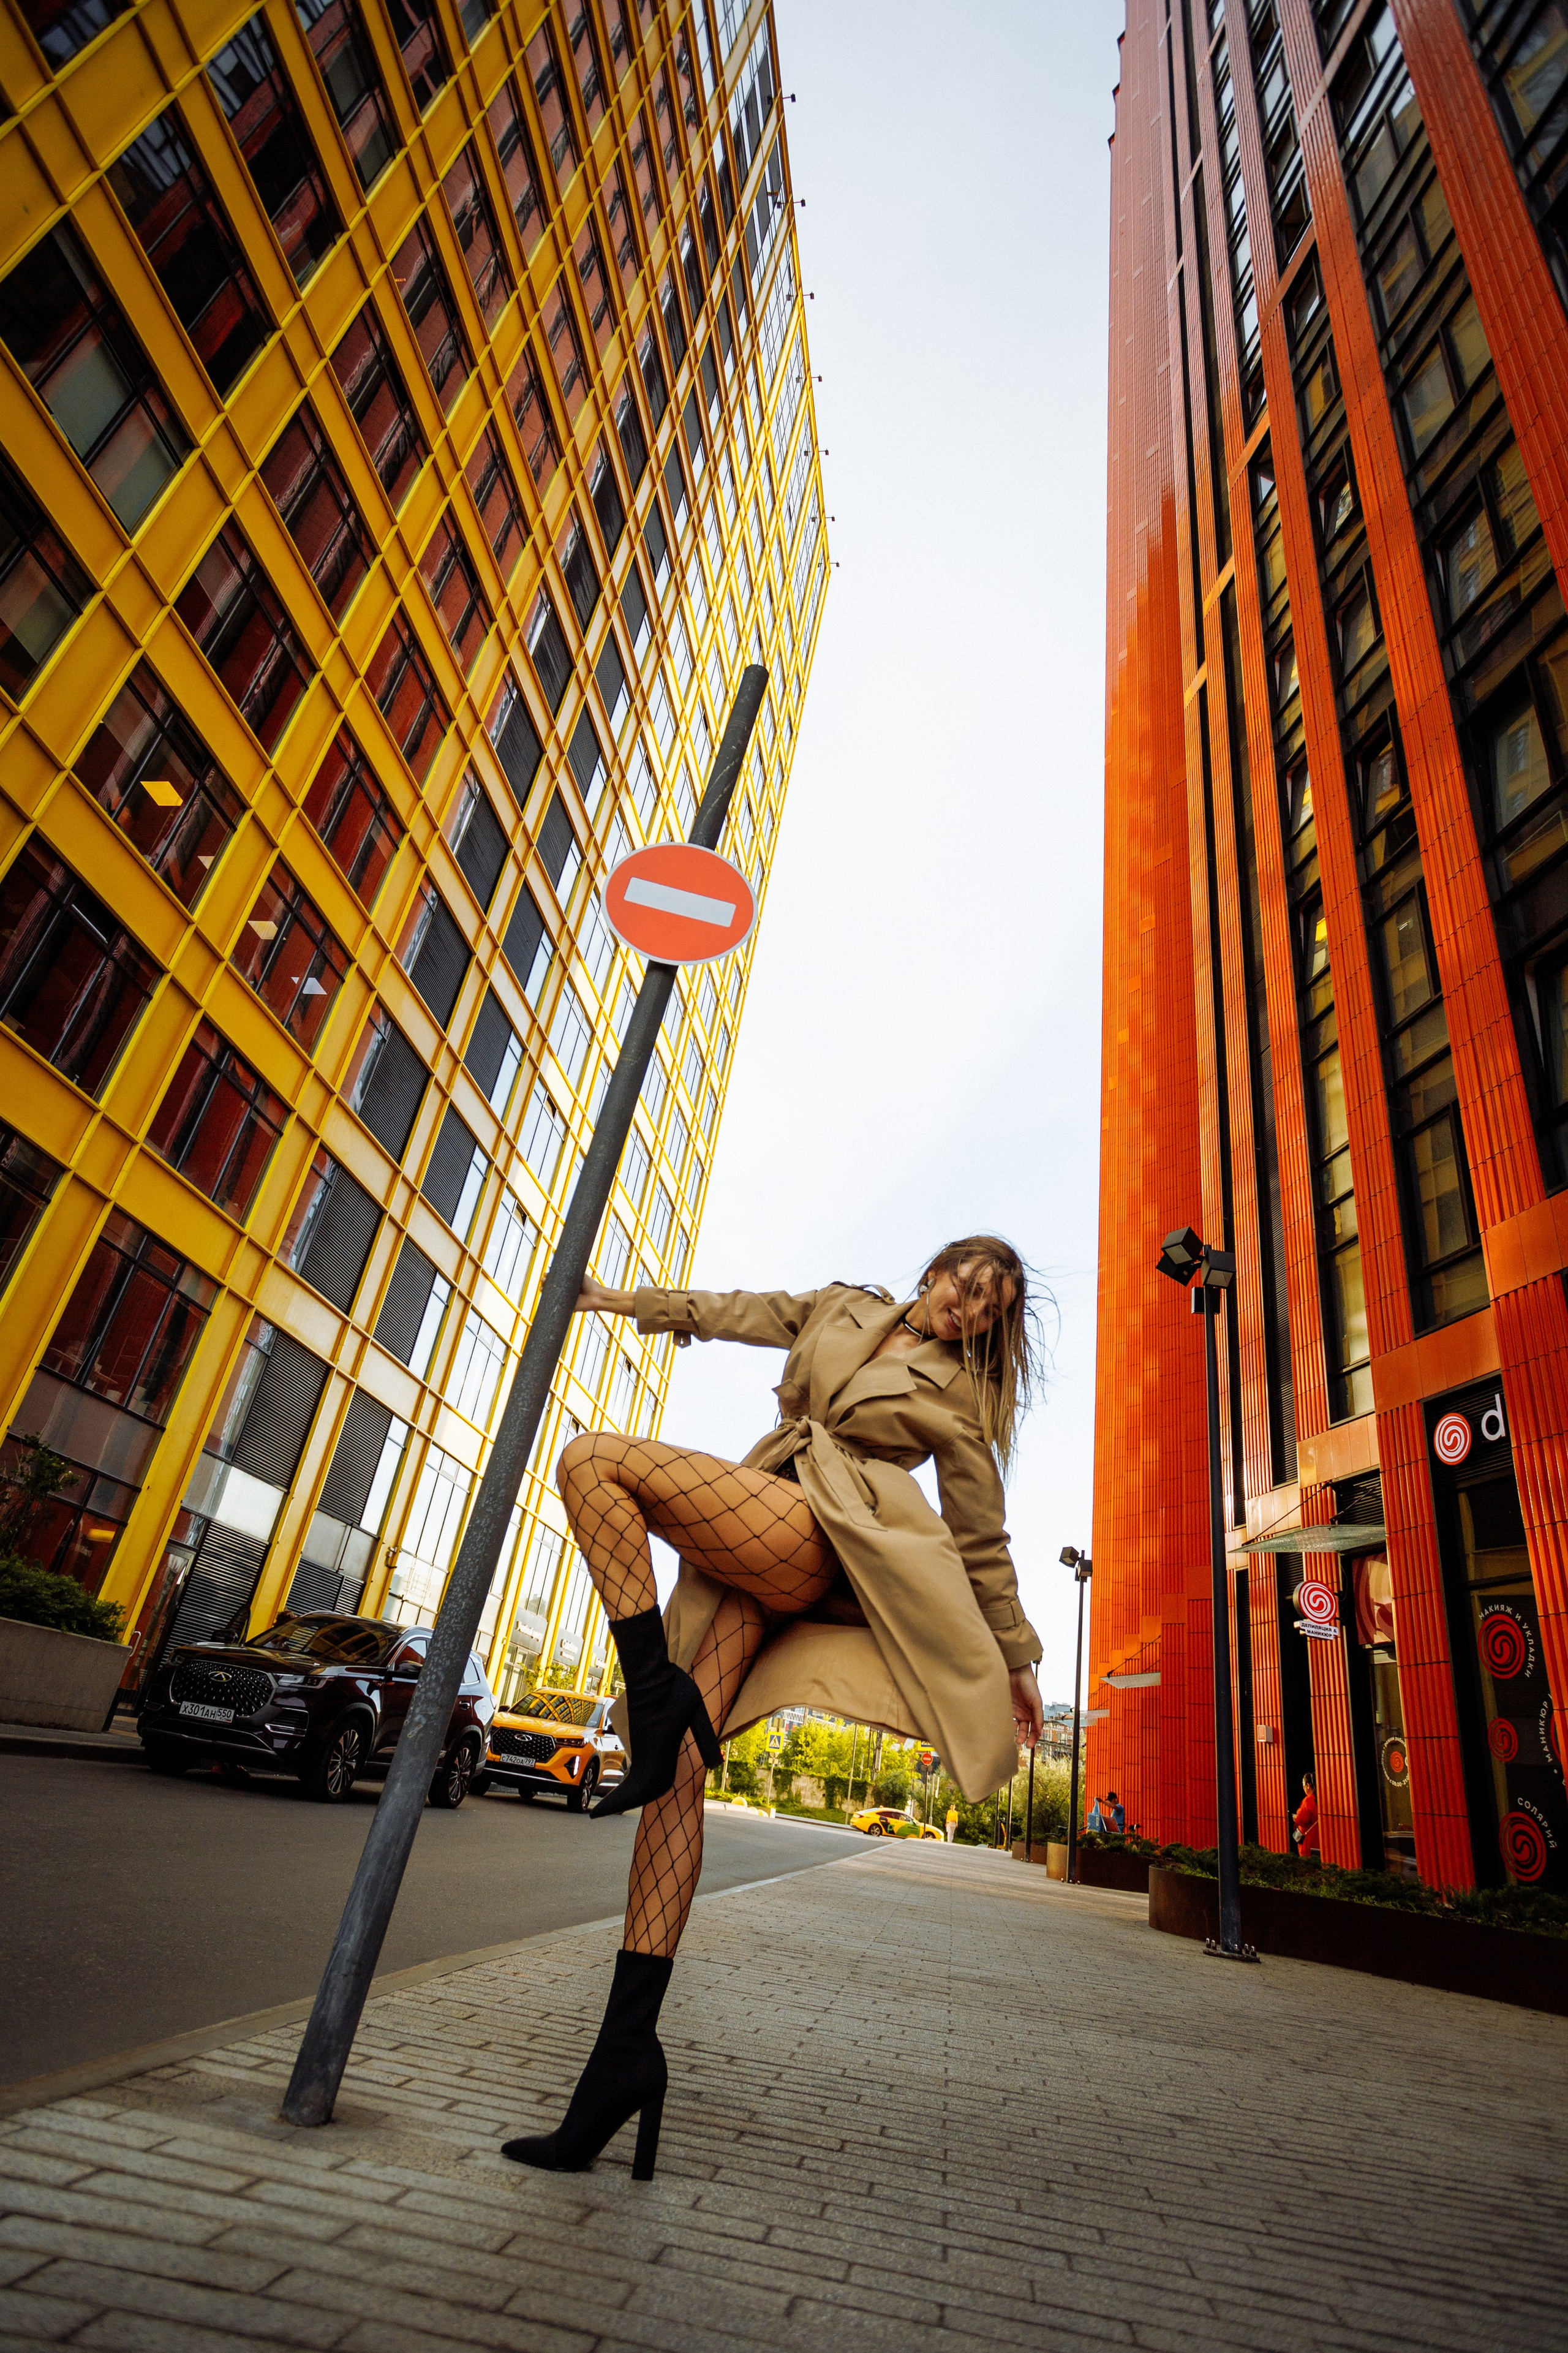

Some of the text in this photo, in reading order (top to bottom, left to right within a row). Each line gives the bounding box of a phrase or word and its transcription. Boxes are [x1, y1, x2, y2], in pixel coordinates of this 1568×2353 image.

[1302, 1623, 1332, 1632] ДЕПИЛЯЦИЯ
[1478, 1604, 1513, 1620] МАКИЯЖ
[1522, 1622, 1535, 1678] УКЛАДКИ
[217, 1708, 232, 1718] 550
[1539, 1701, 1553, 1763] МАНИКЮР
[1517, 1797, 1558, 1848] СОЛЯРИЙ
